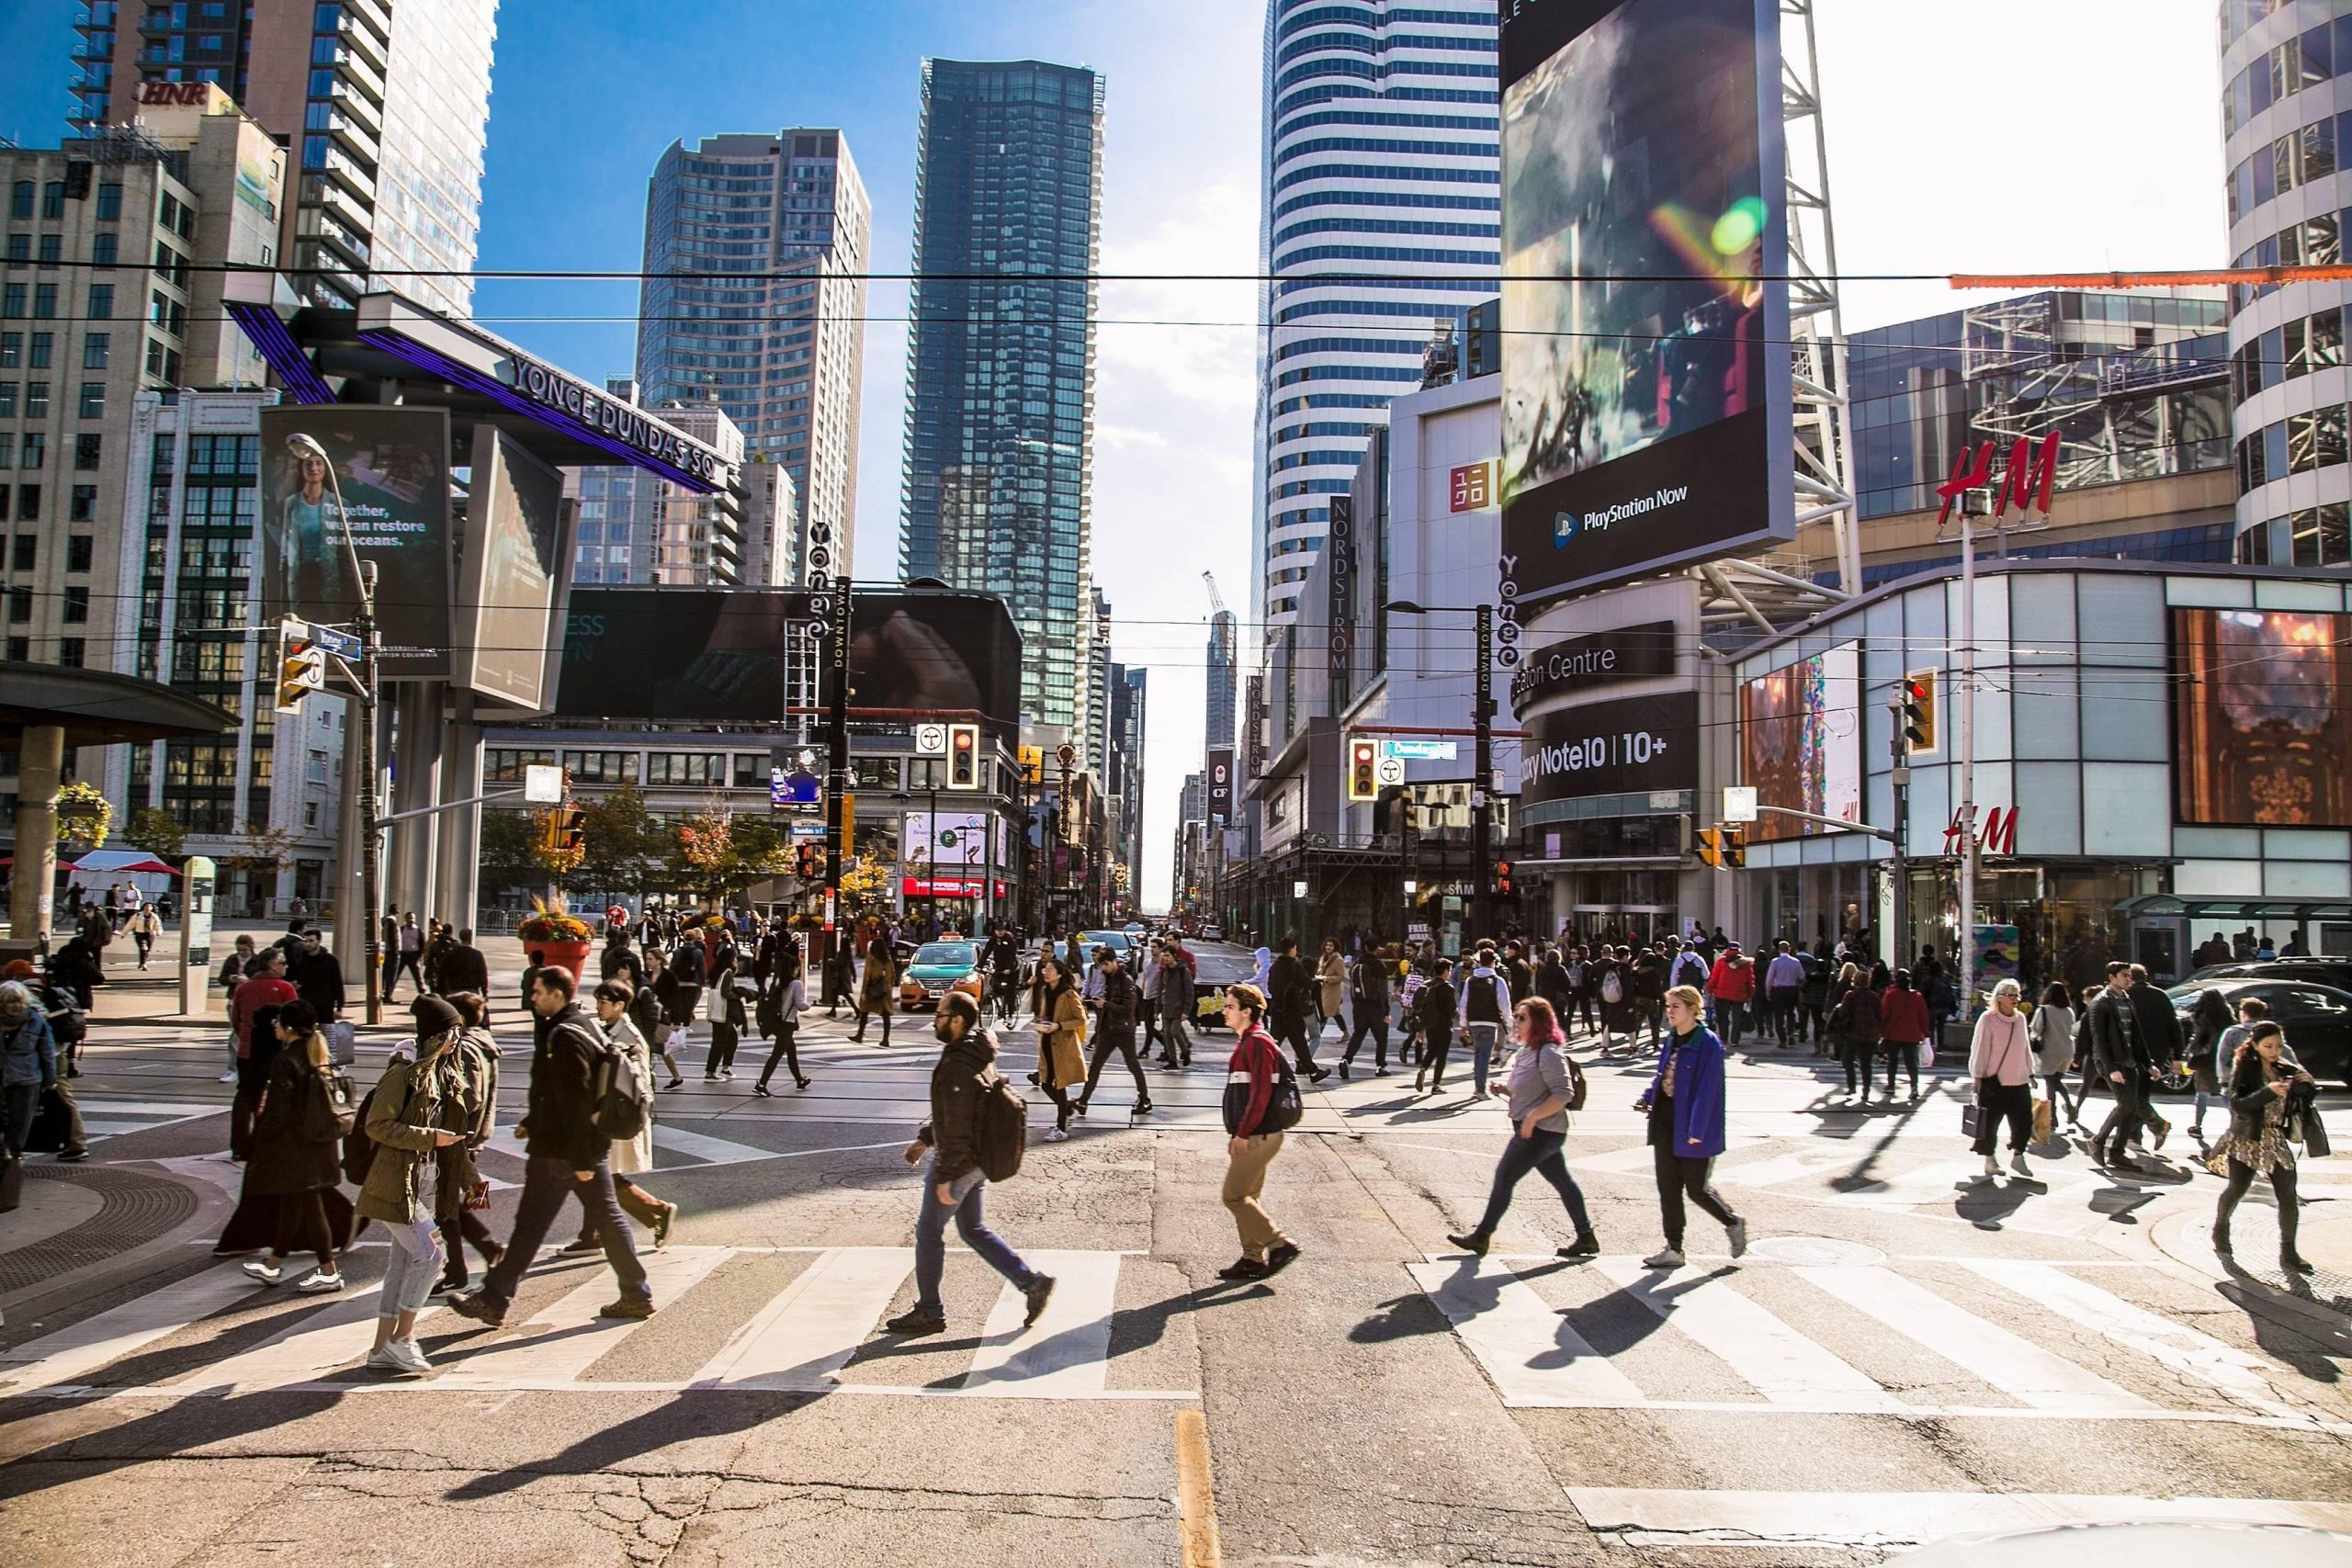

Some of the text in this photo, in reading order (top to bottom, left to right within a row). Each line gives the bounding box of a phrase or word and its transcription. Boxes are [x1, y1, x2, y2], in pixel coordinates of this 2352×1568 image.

[511, 356, 717, 480] YONGE-DUNDAS SQ
[324, 503, 390, 519] Together,
[373, 520, 426, 532] restore
[1584, 486, 1688, 531] PlayStation Now
[353, 536, 404, 547] oceans.
[808, 523, 830, 640] Yonge
[1332, 502, 1348, 669] NORDSTROM
[1499, 553, 1519, 666] Yonge
[834, 584, 846, 668] DOWNTOWN
[1481, 612, 1490, 692] DOWNTOWN
[1549, 649, 1615, 681] Centre
[1250, 679, 1261, 776] NORDSTROM
[1541, 737, 1606, 775] Note10
[1623, 731, 1667, 764] 10+
[1408, 924, 1429, 932] FREE
